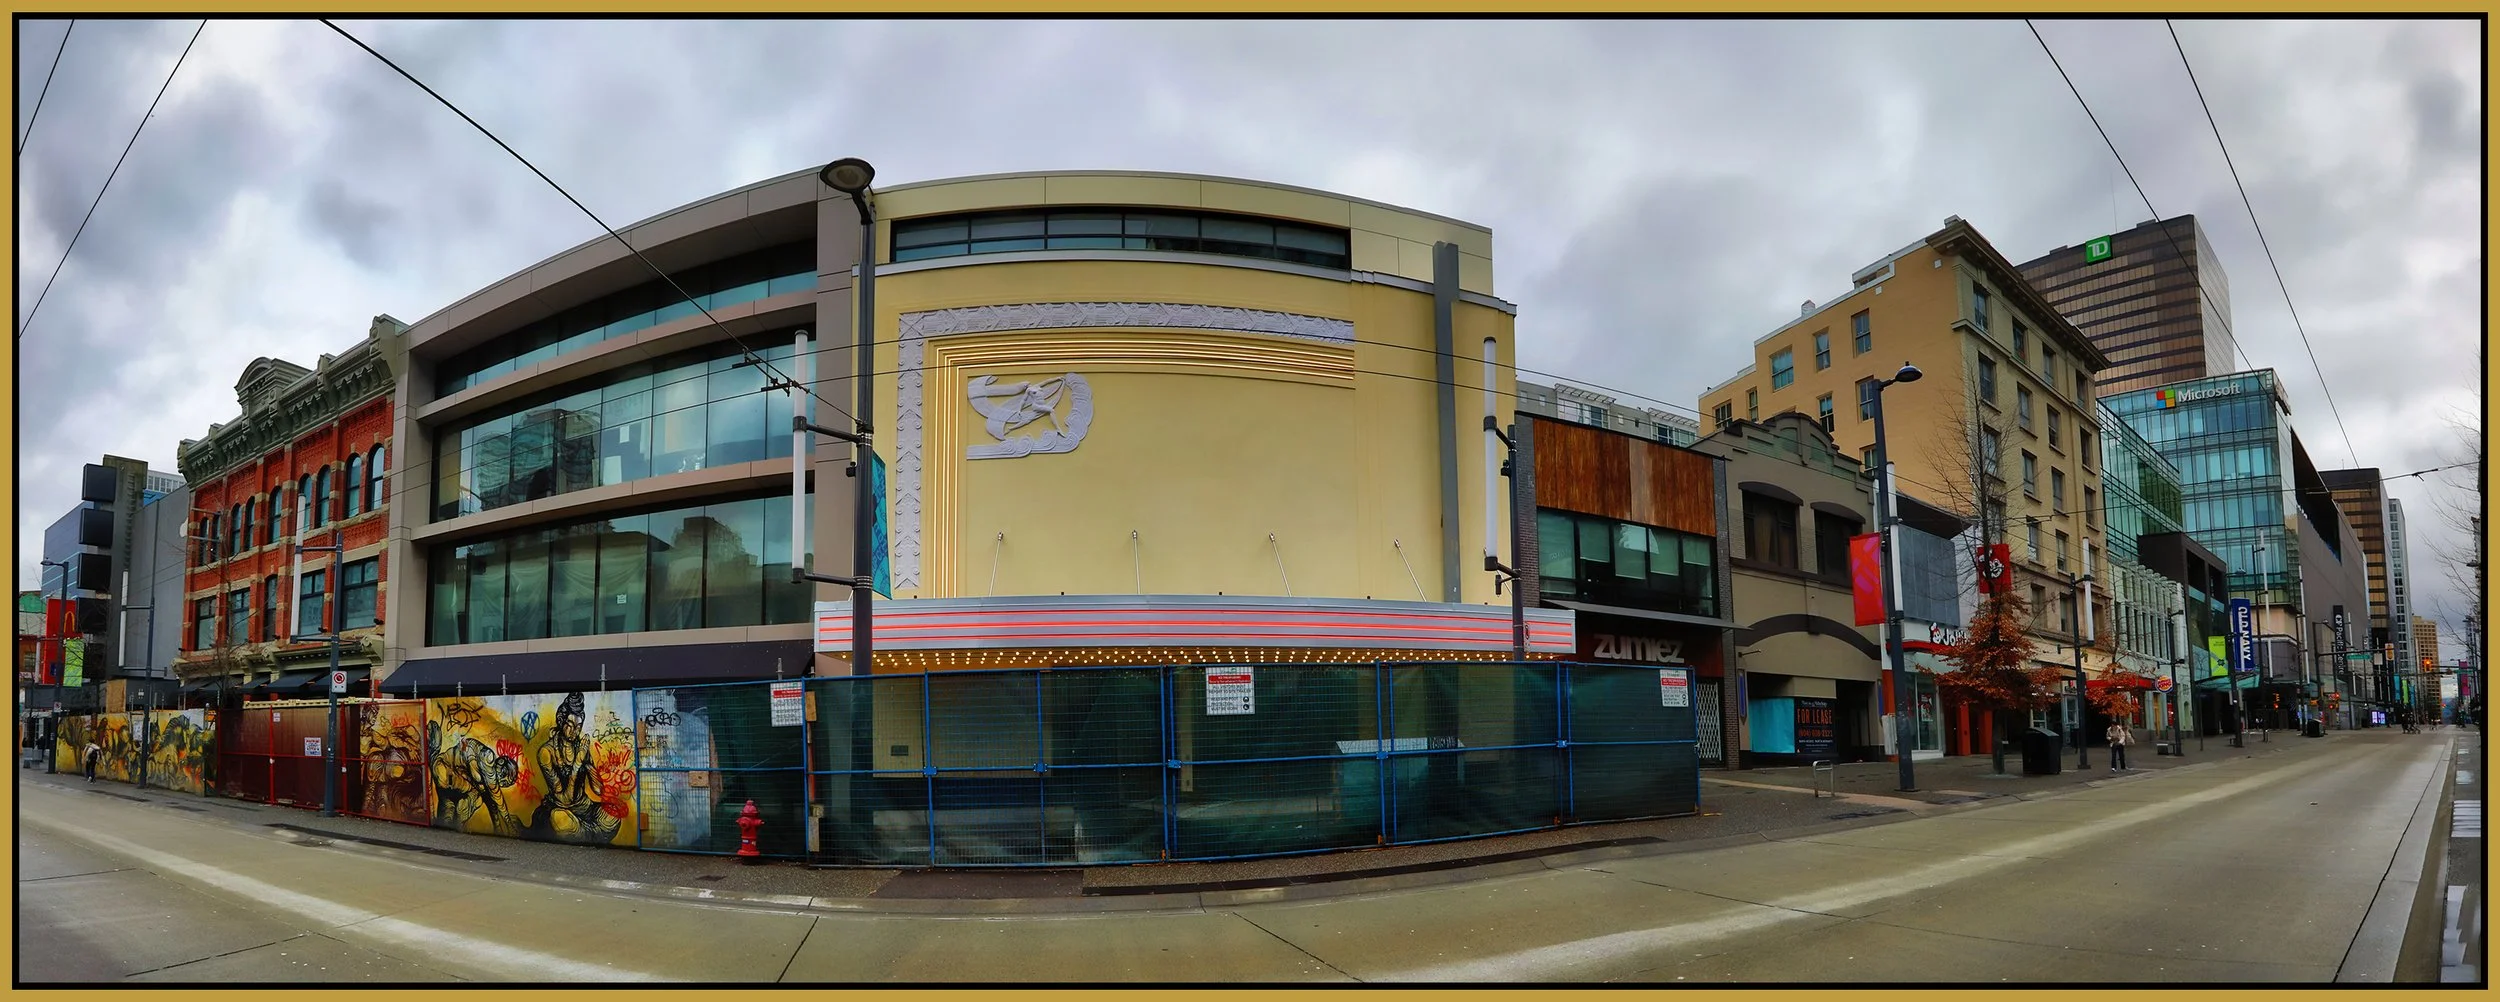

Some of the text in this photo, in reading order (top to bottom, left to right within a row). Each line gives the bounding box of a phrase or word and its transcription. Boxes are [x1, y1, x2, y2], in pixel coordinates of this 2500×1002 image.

[2088, 242, 2109, 257] TD
[2178, 382, 2241, 402] Microsoft
[2237, 606, 2252, 661] OLD NAVY
[1593, 633, 1685, 664] zumiez
[1797, 708, 1833, 725] FOR LEASE
